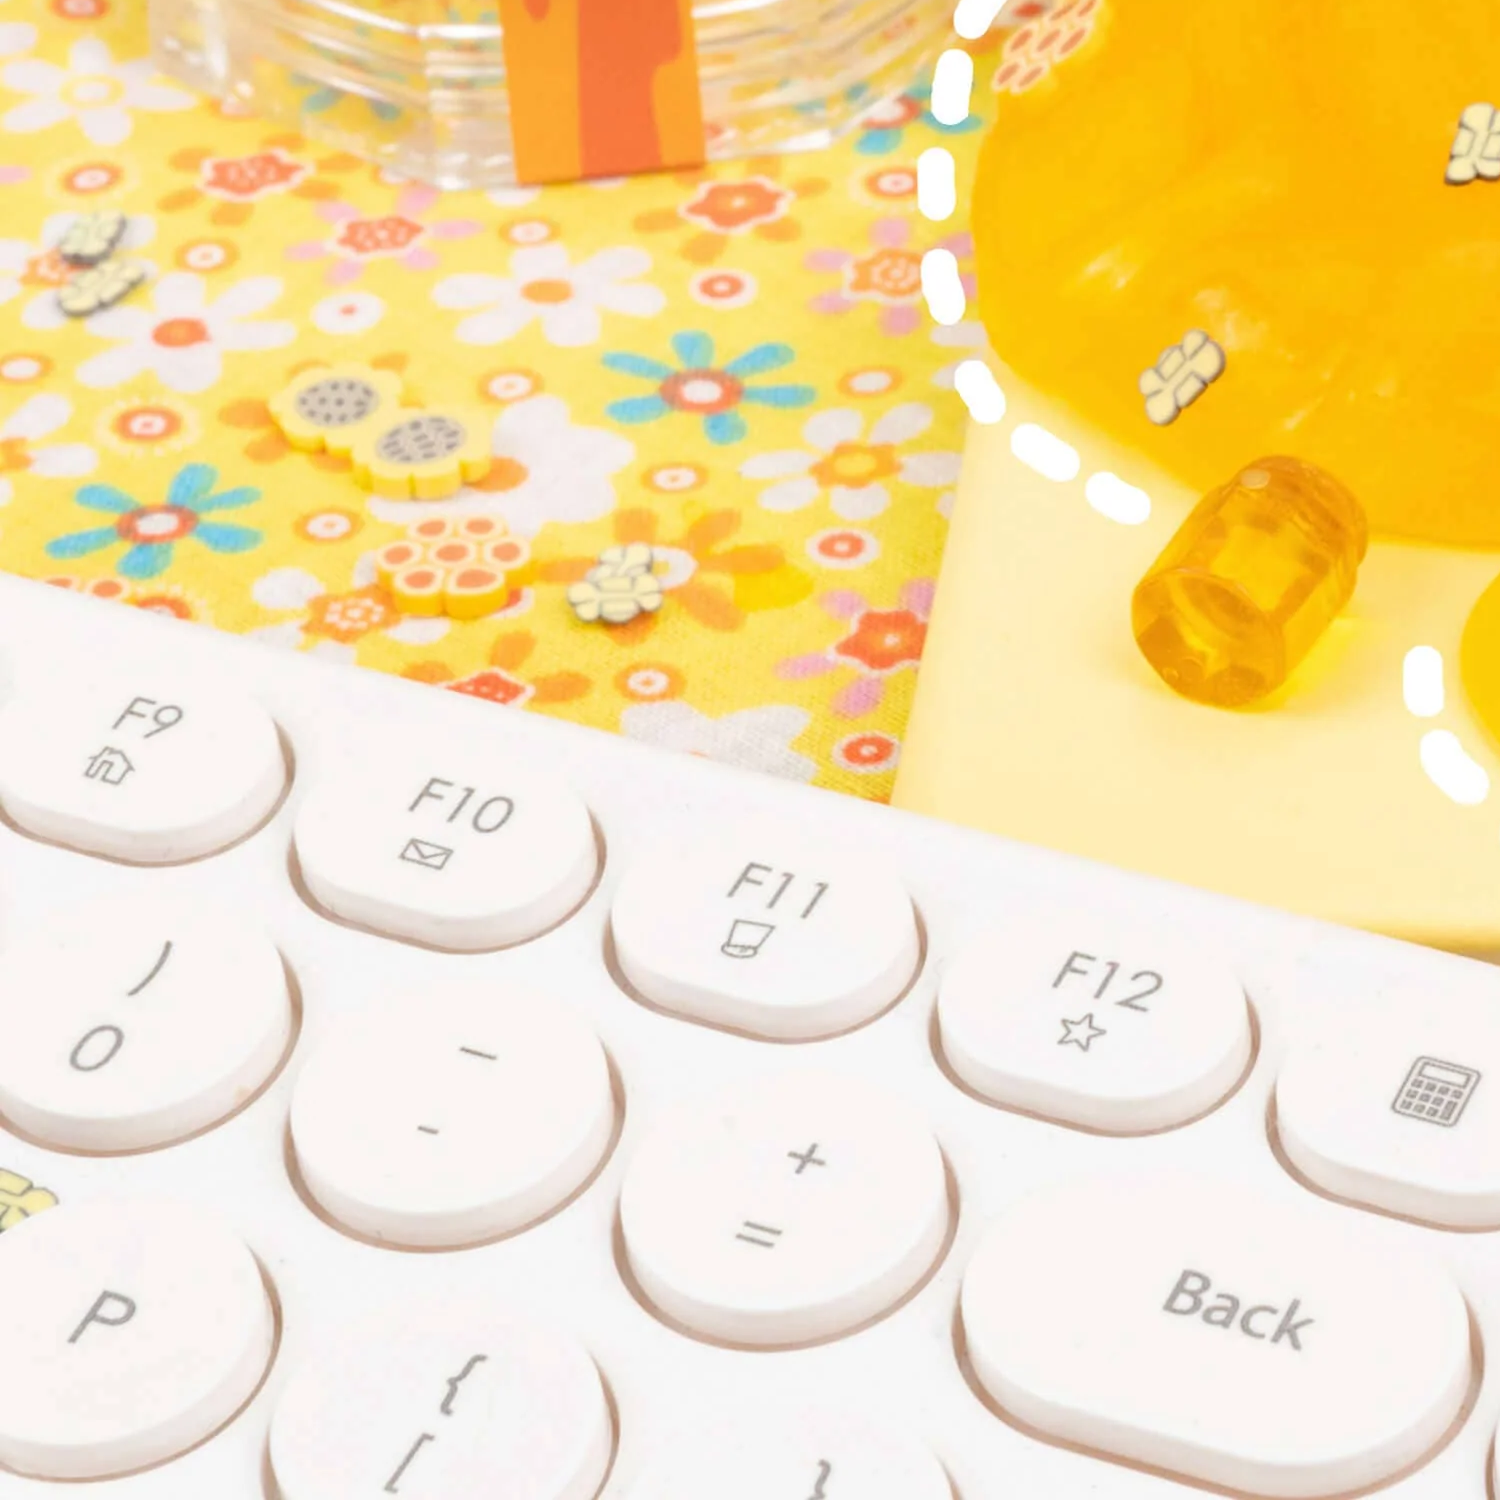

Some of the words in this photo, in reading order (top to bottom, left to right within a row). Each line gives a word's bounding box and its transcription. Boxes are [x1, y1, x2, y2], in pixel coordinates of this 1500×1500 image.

[111, 696, 184, 739] F9
[408, 777, 515, 835] F10
[726, 861, 829, 920] F11
[1051, 950, 1164, 1013] F12
[67, 1289, 137, 1344] P
[1162, 1269, 1315, 1352] Back
